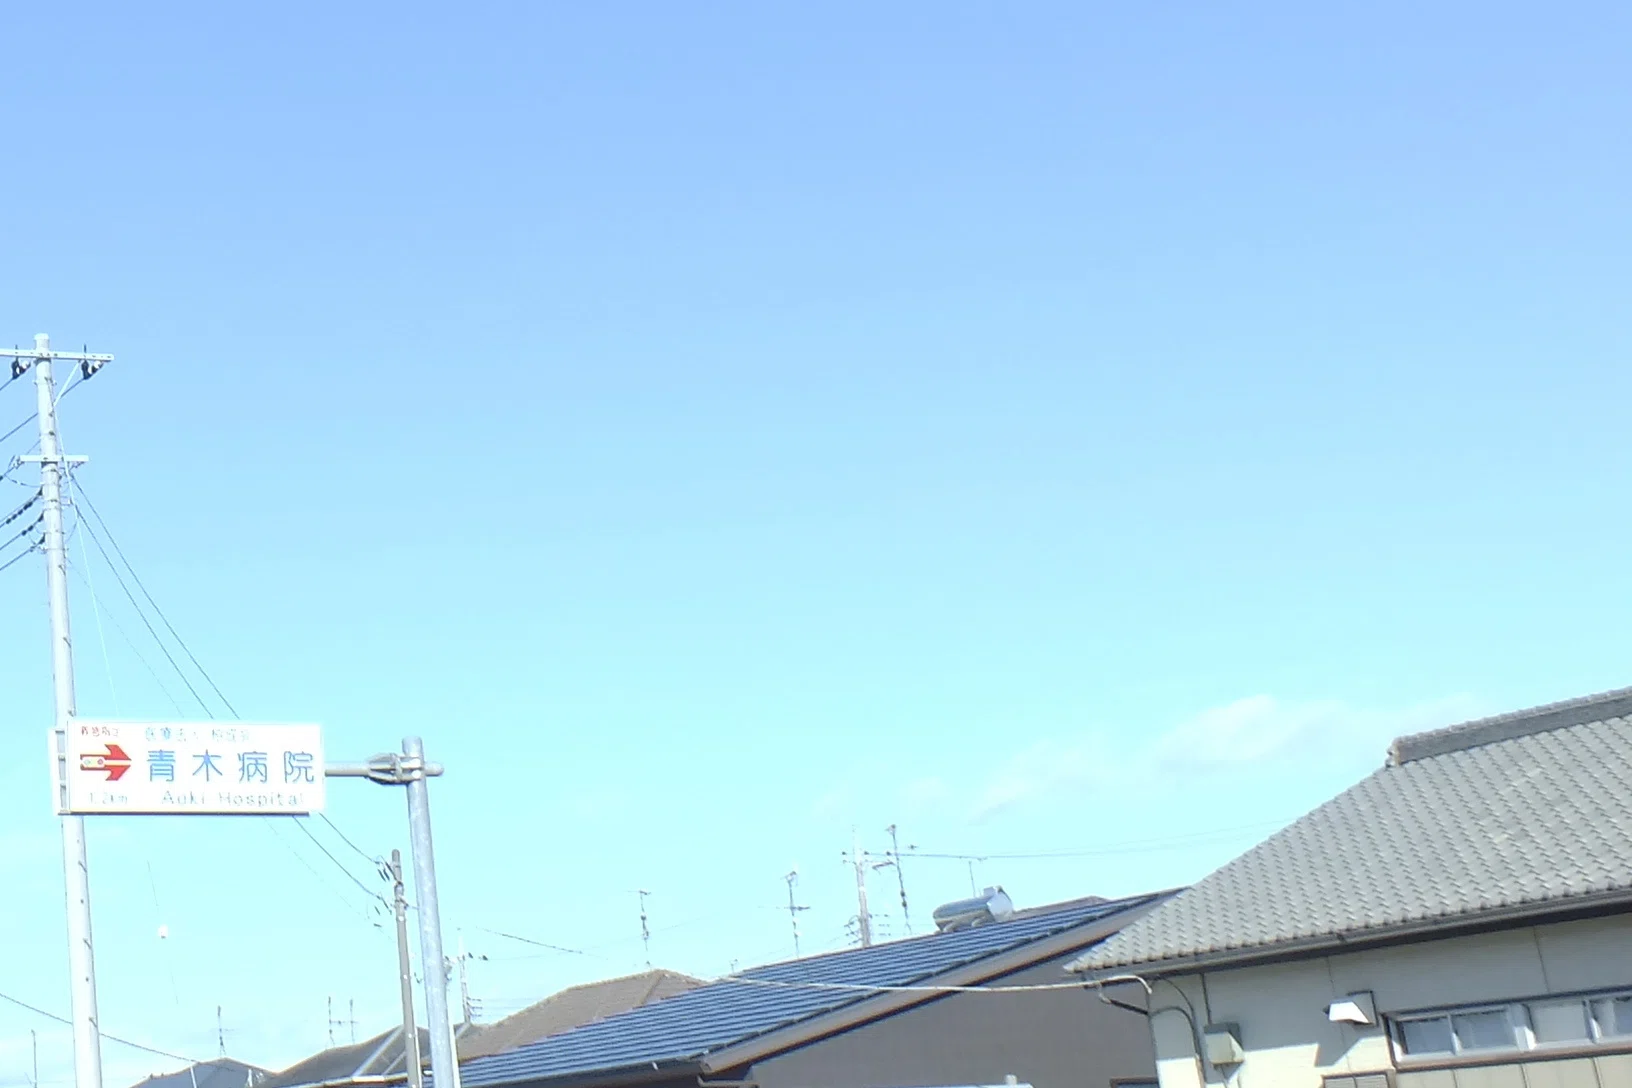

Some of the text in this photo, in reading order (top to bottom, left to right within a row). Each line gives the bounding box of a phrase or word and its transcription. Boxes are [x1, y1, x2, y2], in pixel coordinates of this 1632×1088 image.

[147, 749, 315, 783] 青木病院
[218, 791, 304, 807] Hospital
